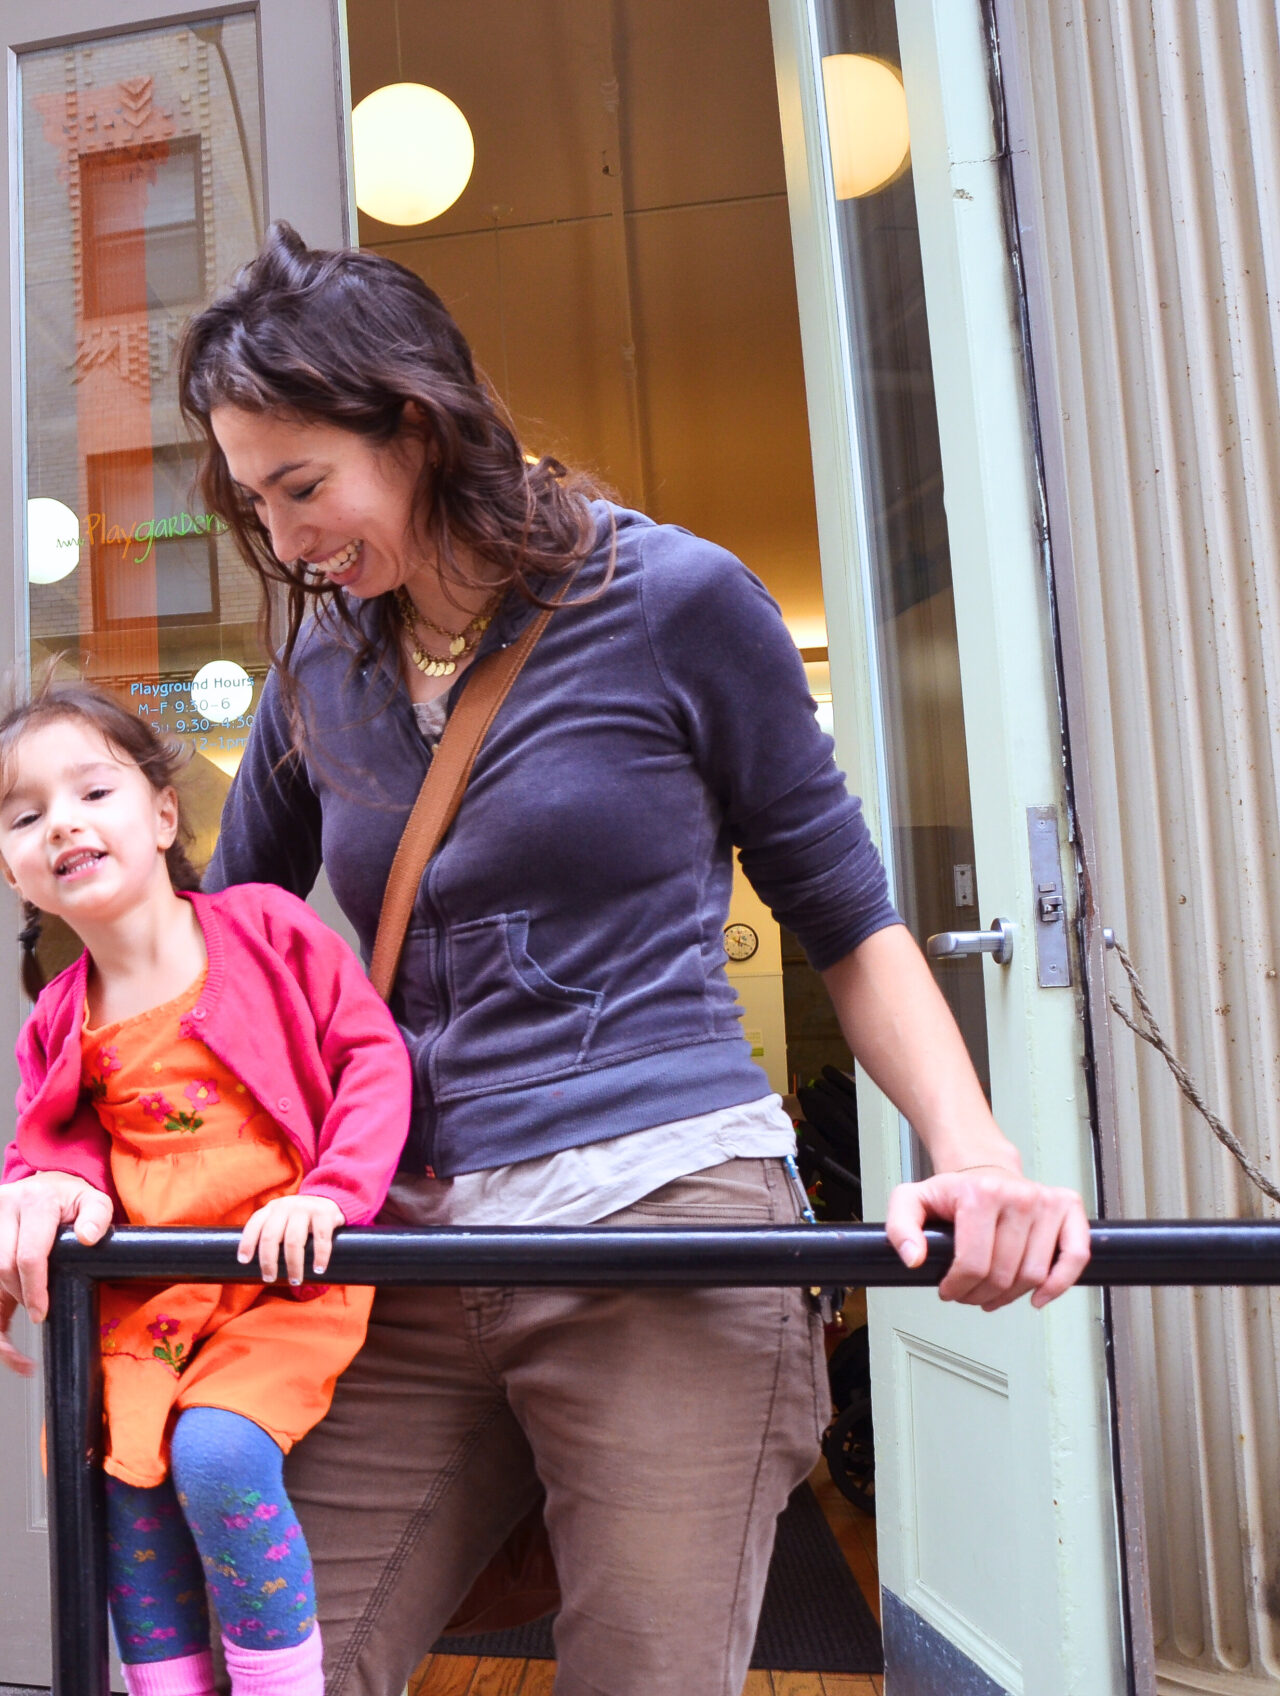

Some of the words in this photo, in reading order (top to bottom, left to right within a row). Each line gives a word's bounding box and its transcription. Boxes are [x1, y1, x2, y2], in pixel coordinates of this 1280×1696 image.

[130, 678, 208, 697] Playground
[213, 676, 255, 689] Hours
[138, 701, 168, 715] M-F
[175, 698, 231, 714] 9:30-6
[176, 715, 255, 732] 9:30-4:30
